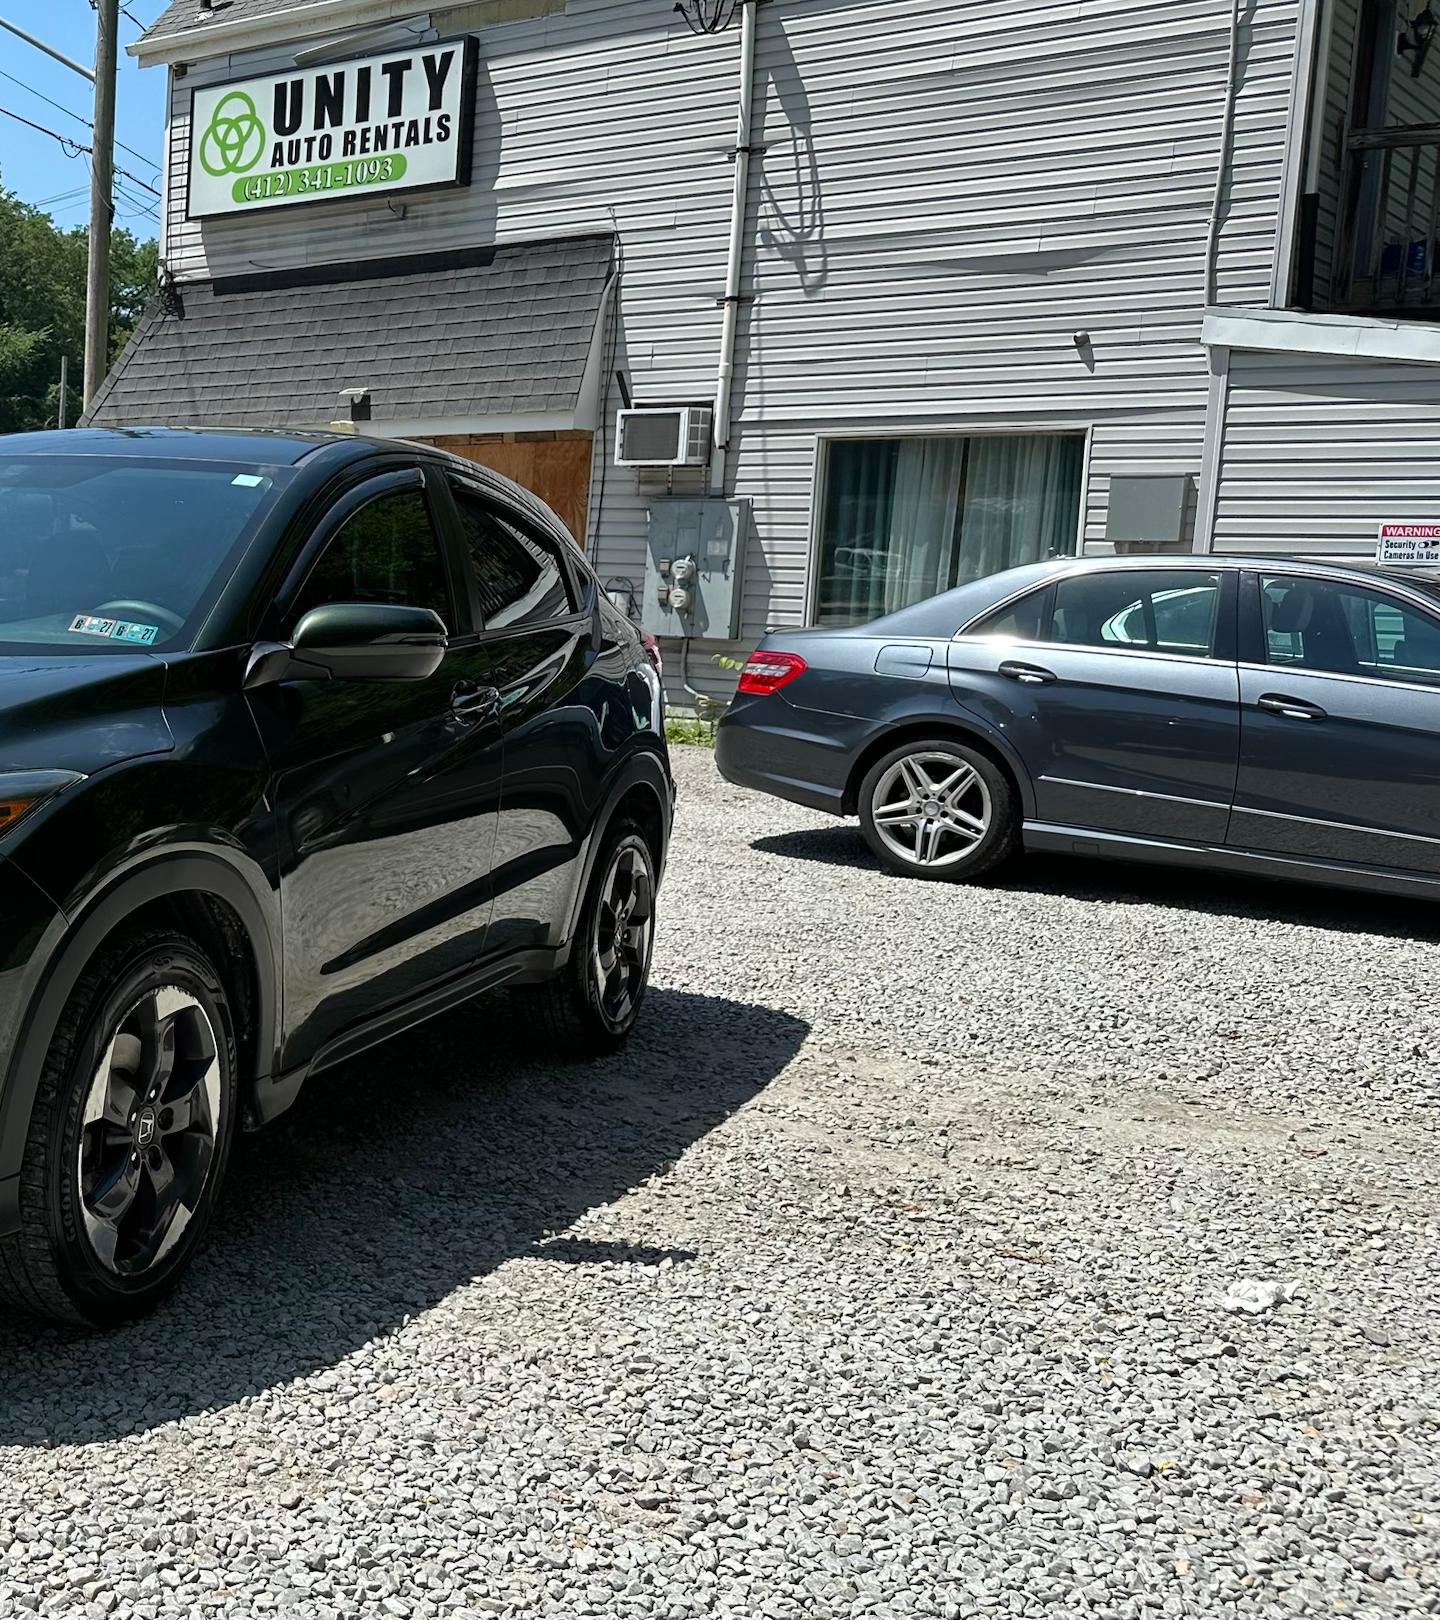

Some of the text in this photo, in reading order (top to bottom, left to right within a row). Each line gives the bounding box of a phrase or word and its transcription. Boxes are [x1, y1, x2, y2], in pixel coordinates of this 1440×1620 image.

[273, 50, 455, 137] UNITY
[270, 113, 452, 168] AUTO RENTALS
[243, 155, 394, 201] (412) 341-1093
[1386, 527, 1440, 536] WARNING
[1384, 551, 1439, 560] Cameras In Use
[1385, 540, 1416, 550] Security
[75, 619, 83, 629] 6
[99, 621, 113, 633] 27
[141, 628, 155, 641] 27
